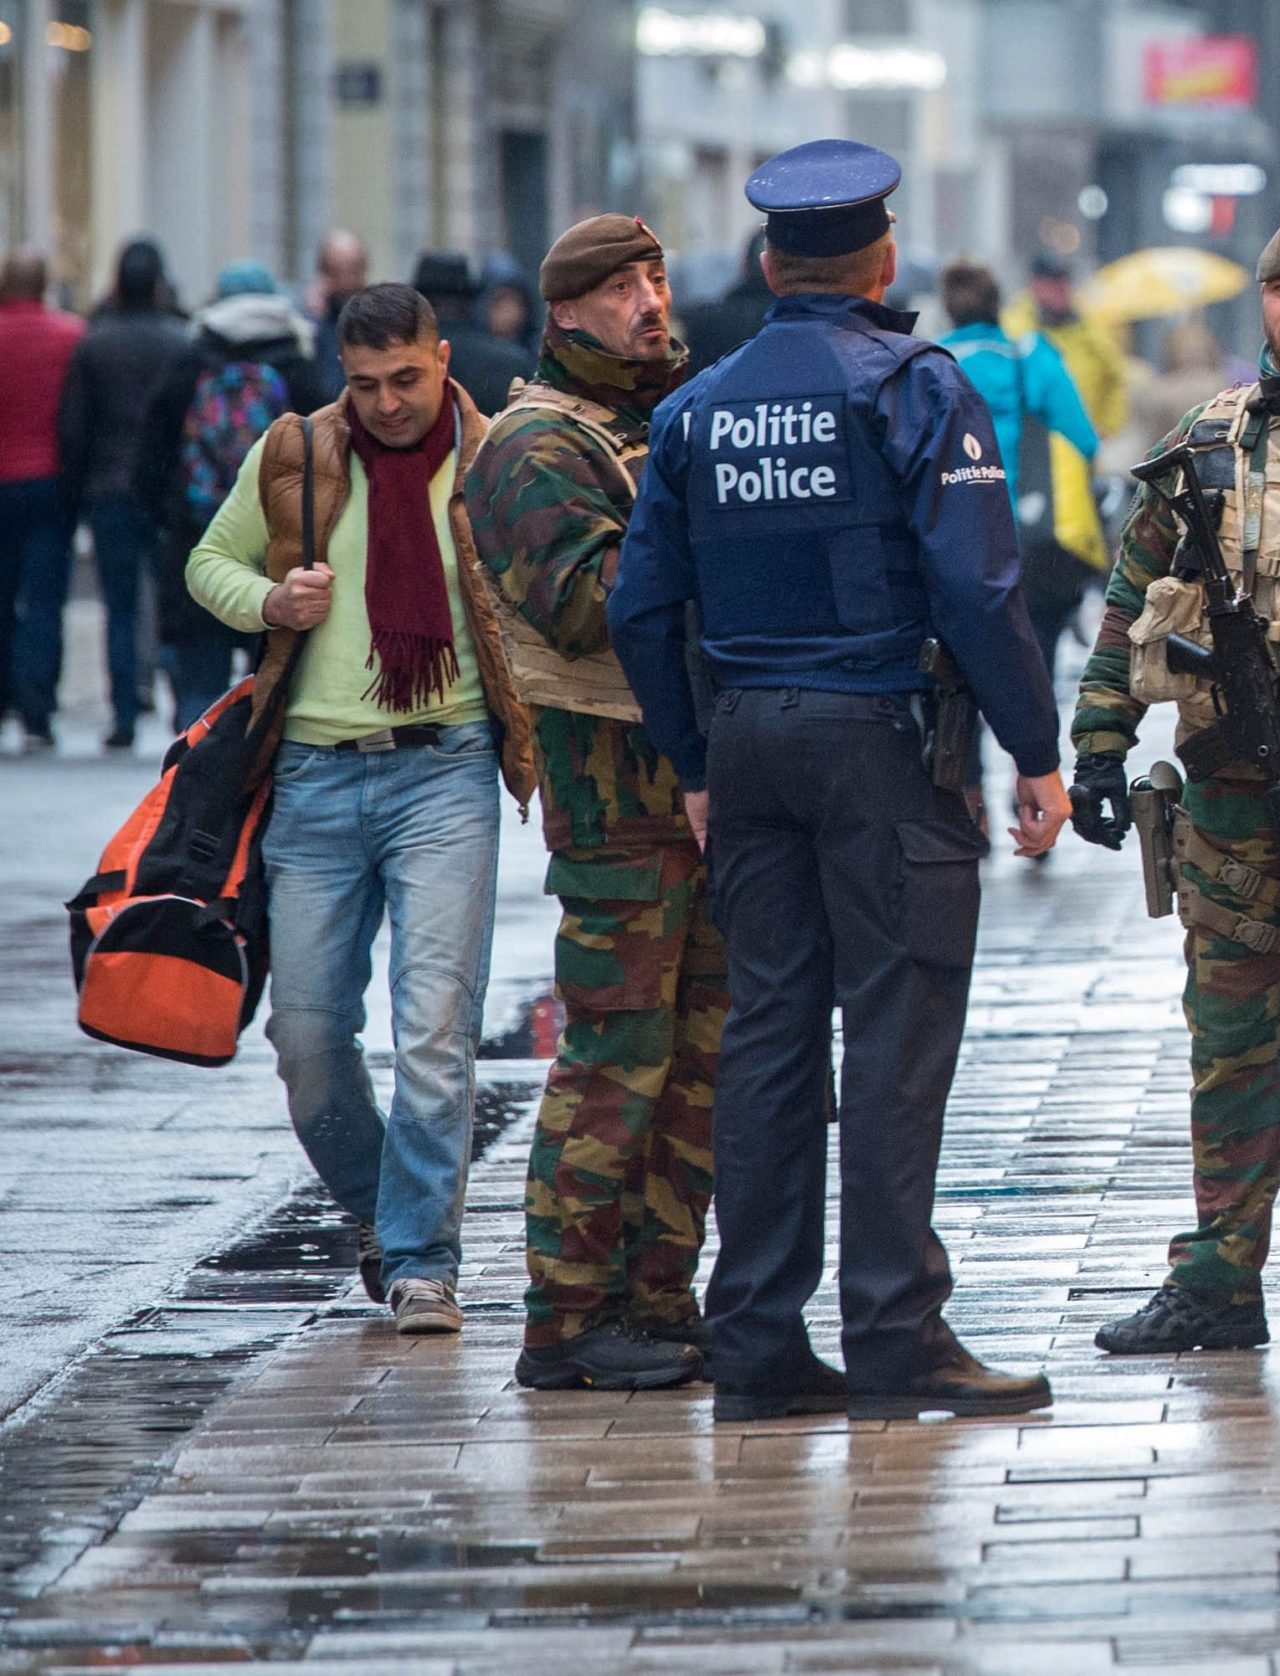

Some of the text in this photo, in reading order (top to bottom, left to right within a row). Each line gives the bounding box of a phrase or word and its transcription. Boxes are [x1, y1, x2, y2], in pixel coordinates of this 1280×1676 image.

[710, 401, 836, 450] Politie
[715, 457, 836, 503] Police
[941, 465, 981, 485] Politie
